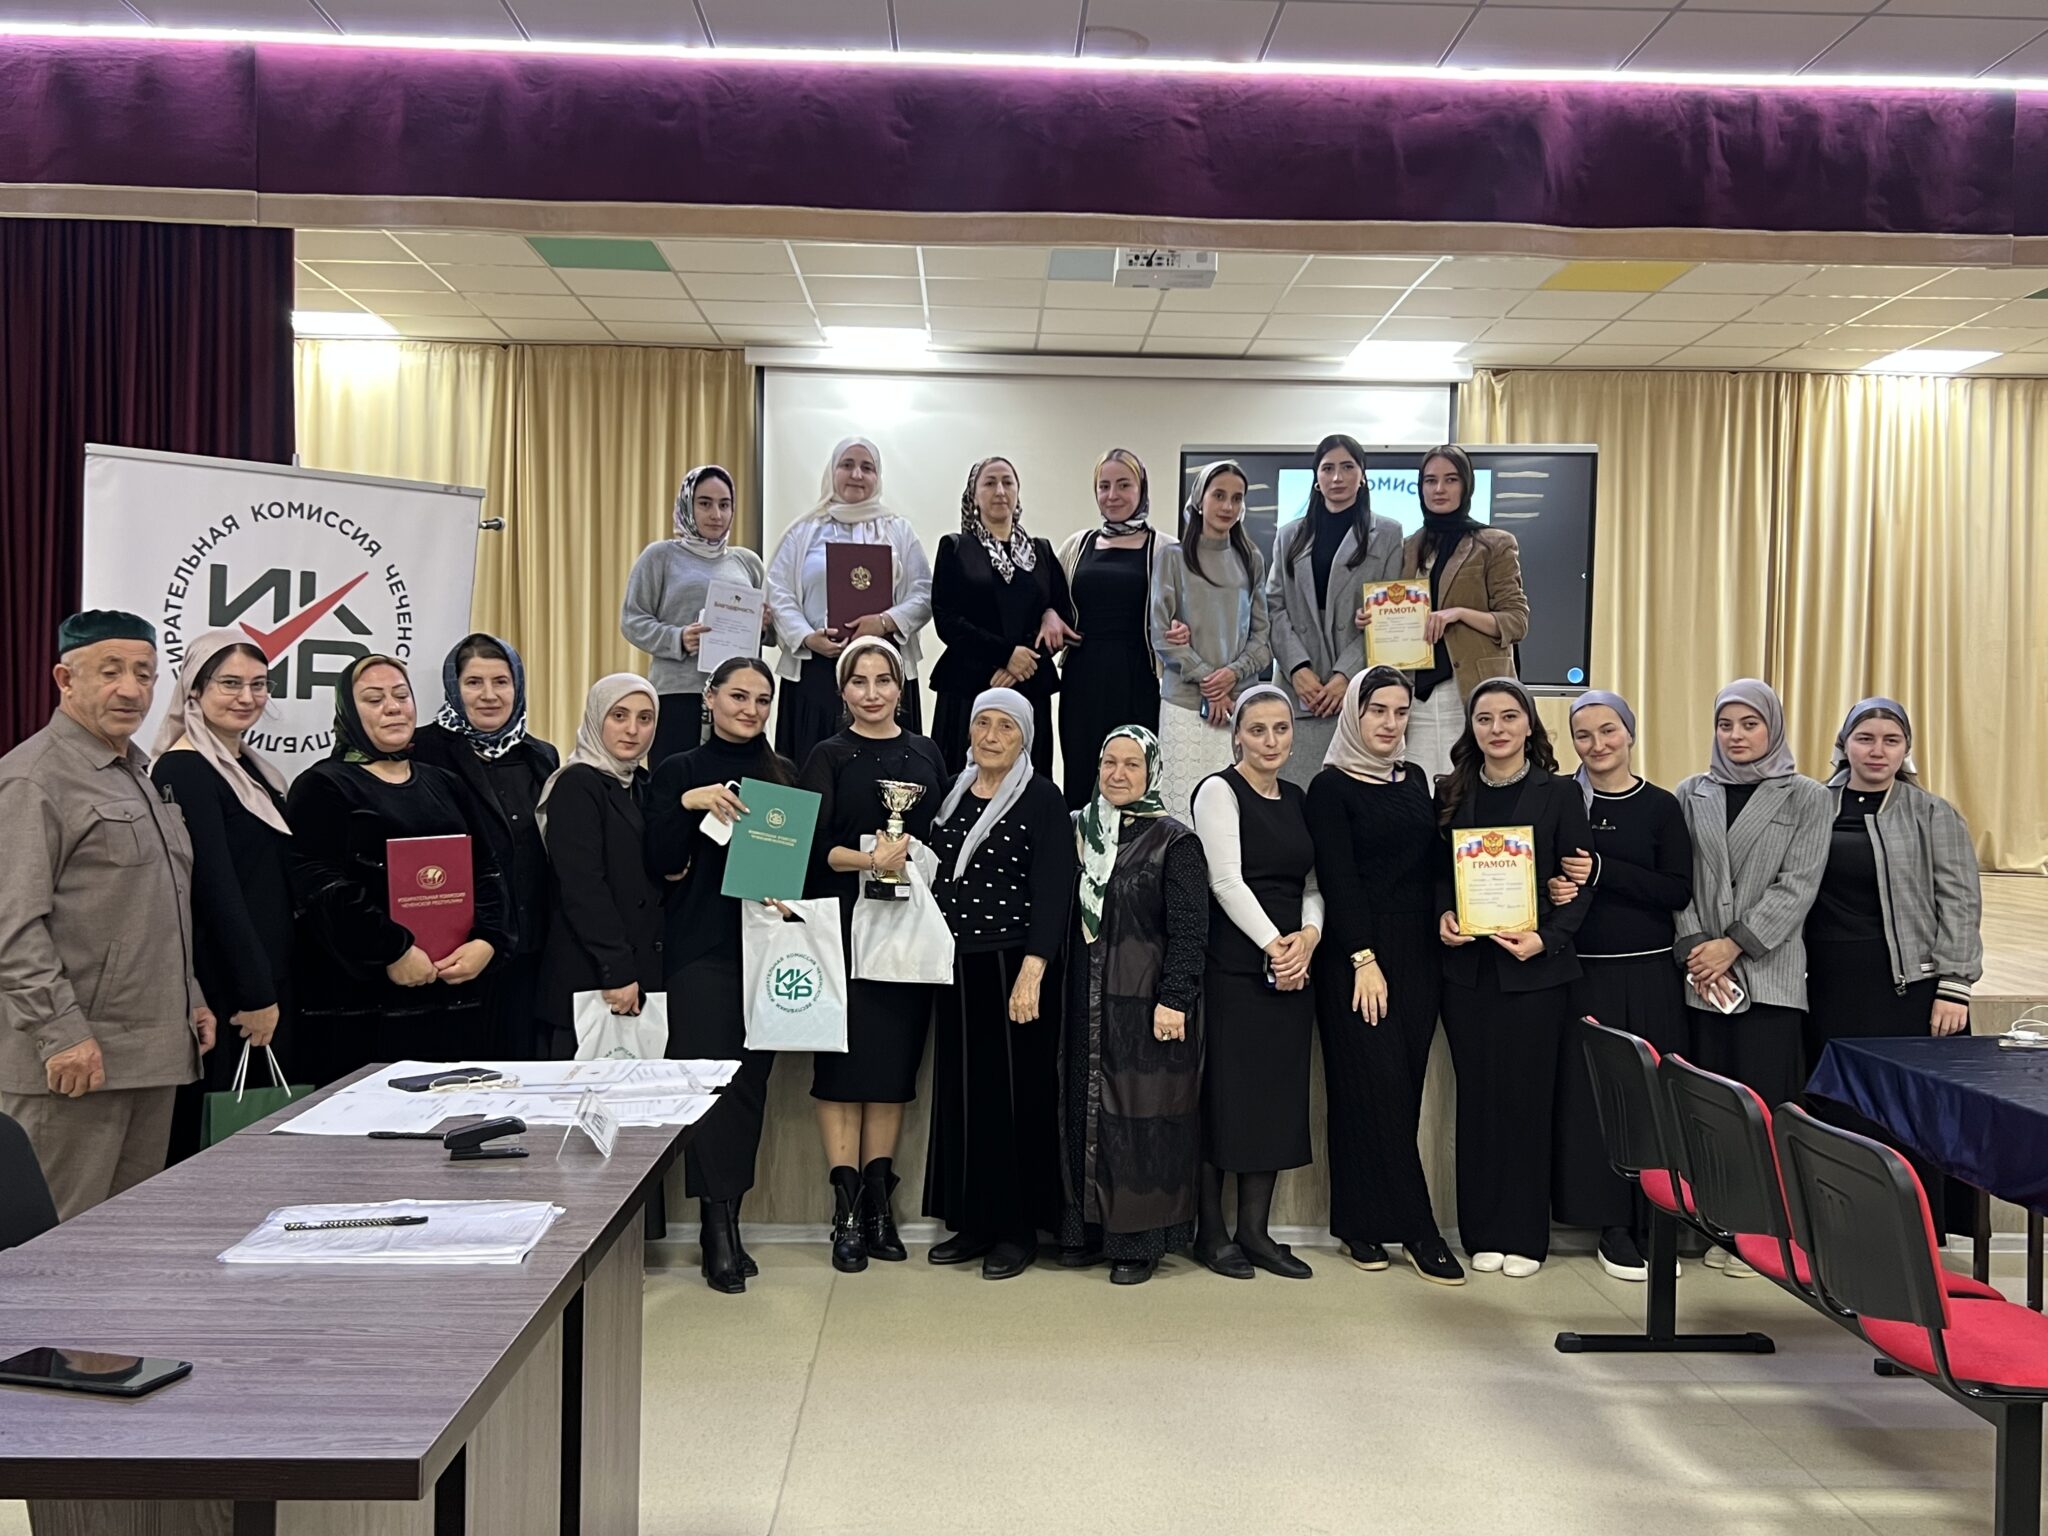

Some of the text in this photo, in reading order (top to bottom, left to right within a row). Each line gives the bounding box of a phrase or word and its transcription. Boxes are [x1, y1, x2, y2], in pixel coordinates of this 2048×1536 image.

[251, 501, 382, 558] КОМИССИЯ
[1378, 606, 1417, 616] ГРАМОТА
[1472, 859, 1517, 869] ГРАМОТА
